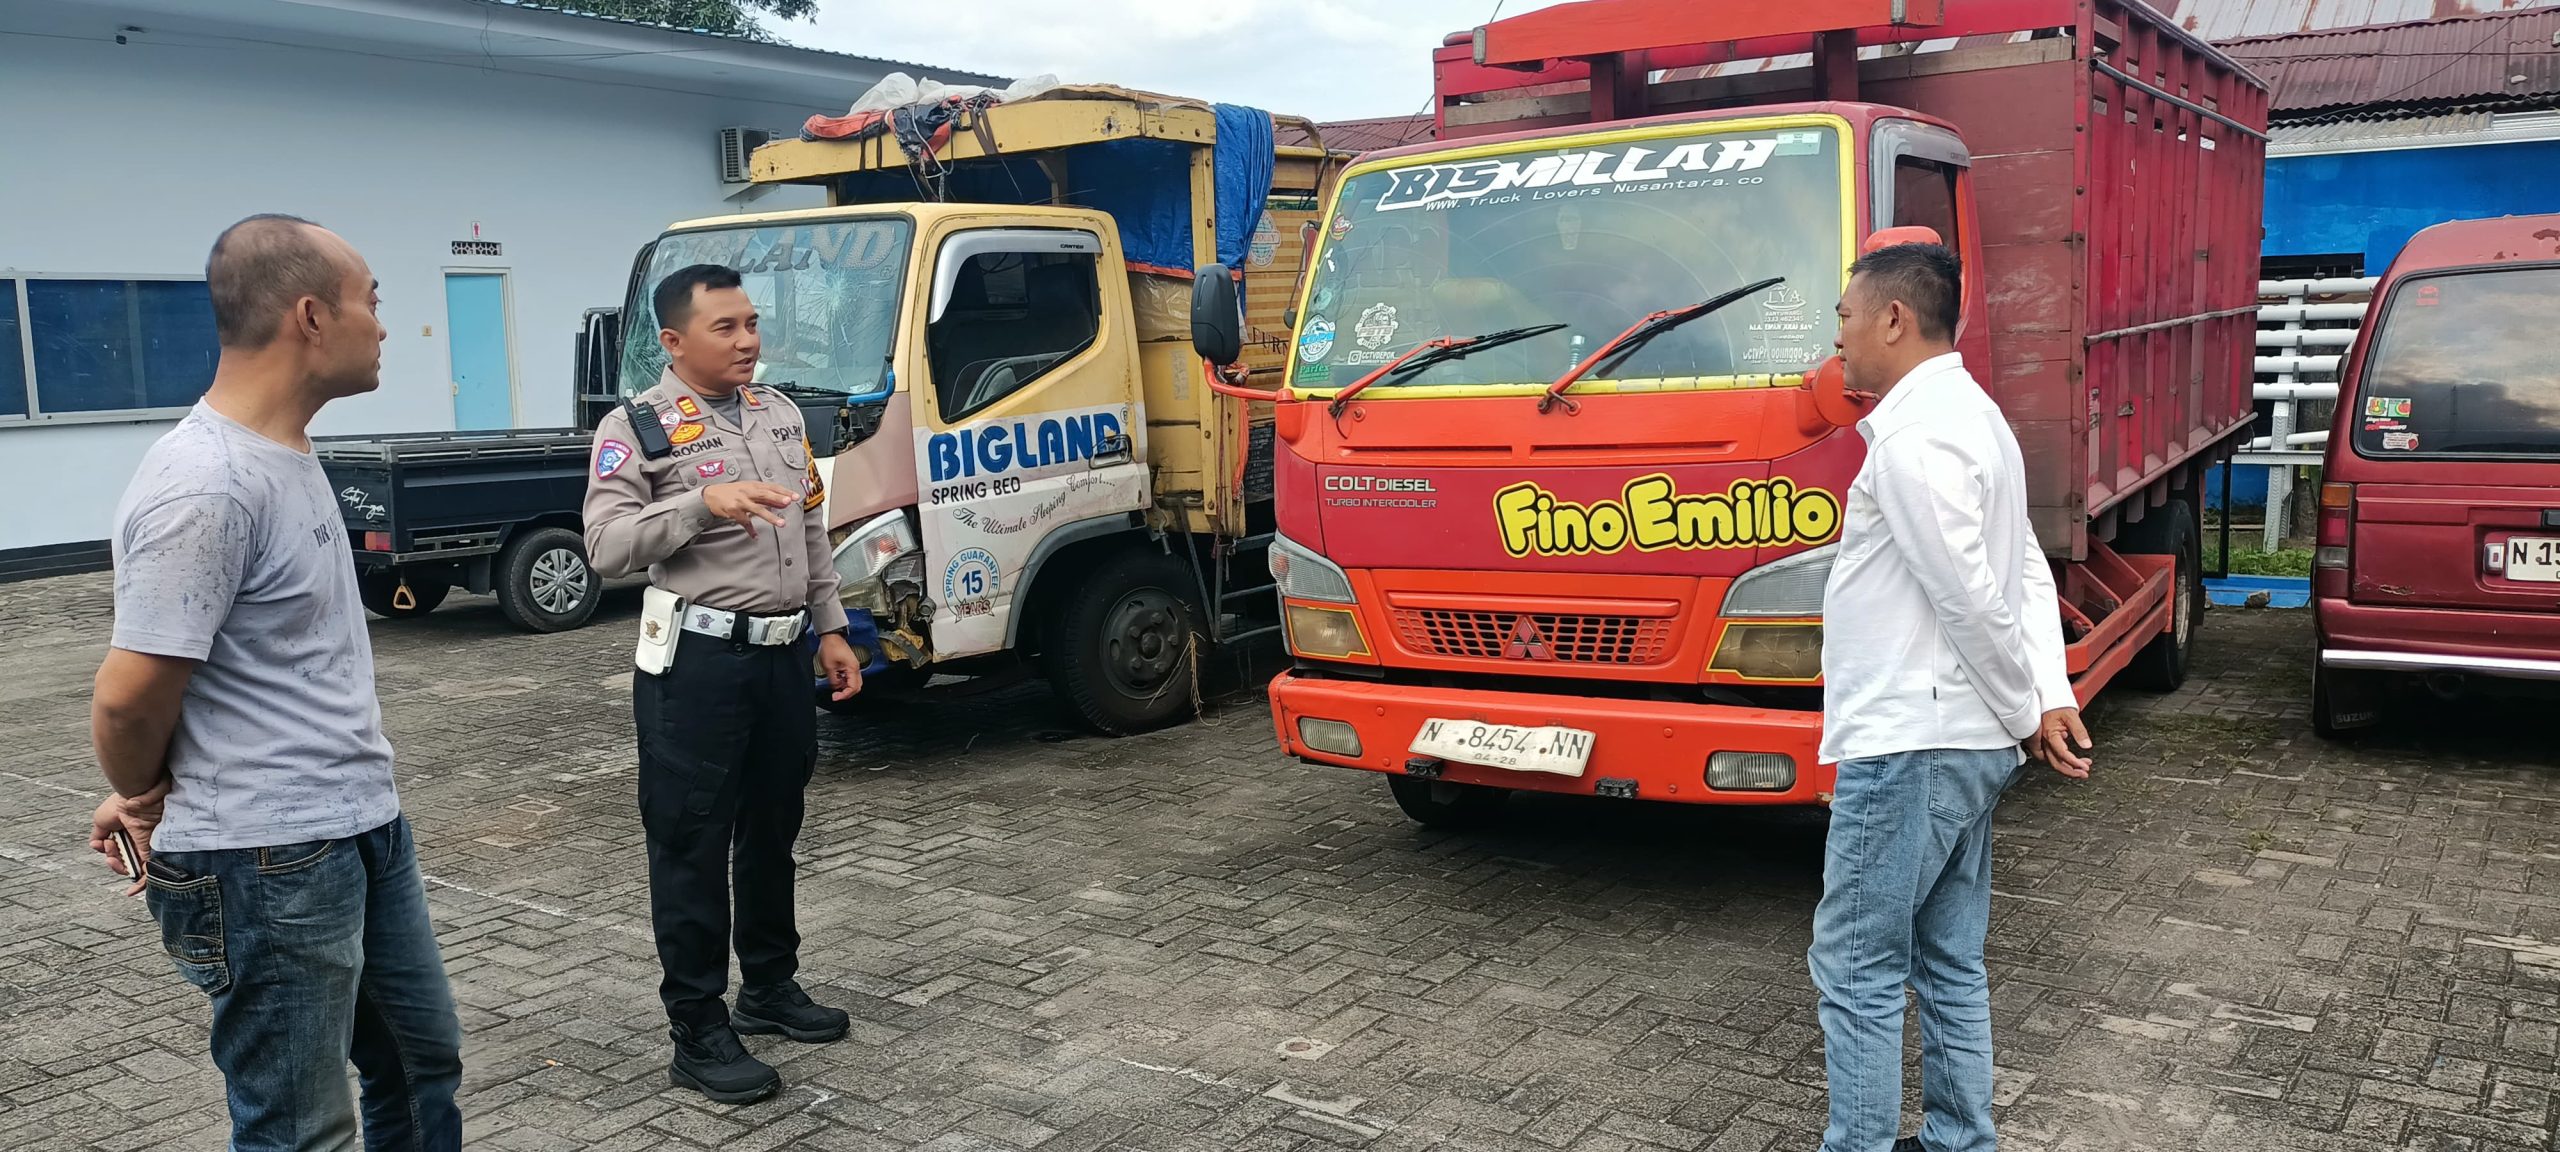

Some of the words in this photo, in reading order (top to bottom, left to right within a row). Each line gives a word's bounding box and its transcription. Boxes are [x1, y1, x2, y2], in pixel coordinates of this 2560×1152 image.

[1375, 138, 1777, 212] BISMILLAH
[1469, 193, 1521, 207] Truck
[1532, 187, 1602, 201] Lovers
[1737, 176, 1763, 186] co
[671, 436, 724, 459] ROCHAN
[928, 412, 1122, 483] BIGLAND
[931, 482, 987, 505] SPRING
[993, 476, 1021, 496] BED
[1325, 476, 1376, 491] COLT
[1375, 478, 1436, 492] DIESEL
[953, 507, 978, 529] The
[982, 517, 1027, 535] Ultimate
[1029, 491, 1066, 525] Sleeping
[1326, 498, 1360, 507] TURBO
[1362, 499, 1437, 508] INTERCOOLER
[1494, 483, 1629, 559] Fino
[1622, 474, 1842, 553] Emilio
[2512, 542, 2527, 565] N
[945, 559, 959, 599] SPRING
[960, 550, 999, 590] GUARANTEE
[962, 570, 983, 596] 15
[954, 599, 991, 620] YEARS
[1422, 721, 1443, 742] N
[1468, 725, 1532, 755] 8454
[1550, 730, 1587, 760] NN
